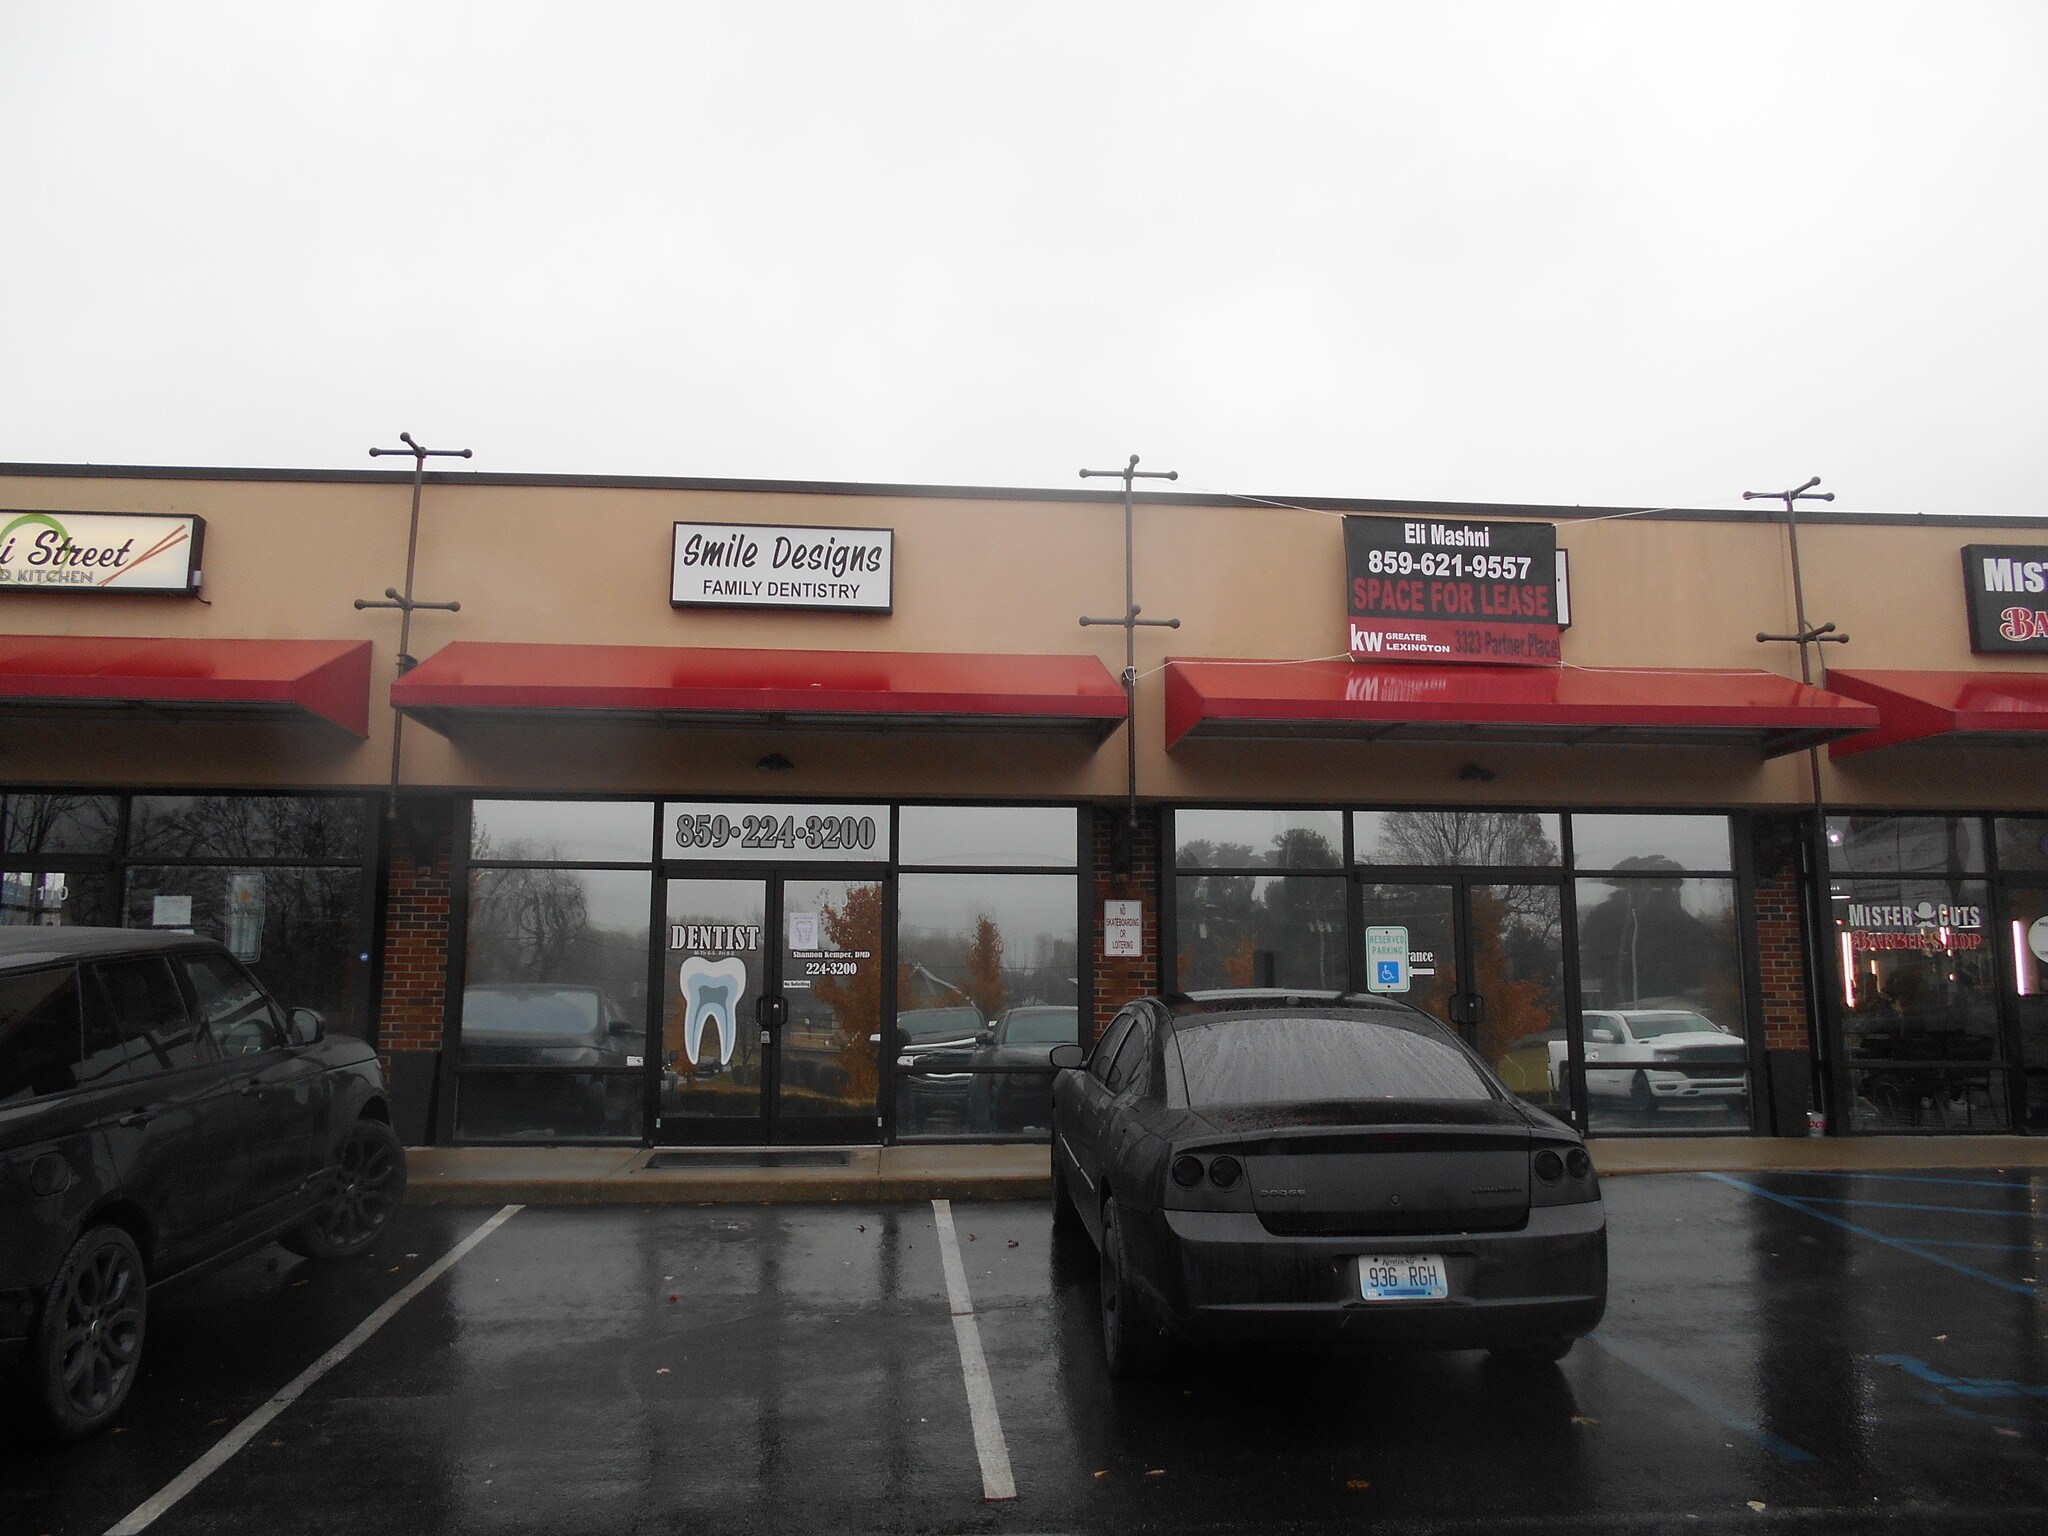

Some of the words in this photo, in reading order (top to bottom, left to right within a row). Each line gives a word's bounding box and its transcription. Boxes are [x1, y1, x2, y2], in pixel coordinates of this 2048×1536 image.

[1404, 523, 1426, 544] Eli
[1431, 524, 1490, 547] Mashni
[0, 537, 16, 565] i
[27, 530, 135, 568] Street
[683, 533, 759, 568] Smile
[772, 536, 883, 578] Designs
[1368, 550, 1531, 580] 859-621-9557
[17, 569, 94, 584] KITCHEN
[703, 580, 762, 596] FAMILY
[767, 581, 861, 599] DENTISTRY
[1353, 577, 1425, 612] SPACE
[1430, 580, 1475, 614] FOR
[1480, 583, 1550, 617] LEASE
[1350, 624, 1383, 652] kw
[1385, 632, 1427, 641] GREATER
[1528, 633, 1558, 657] Place
[1386, 643, 1450, 653] LEXINGTON
[1119, 907, 1127, 915] NO
[1849, 904, 1913, 927] MISTER
[1937, 903, 1980, 927] CUTS
[671, 925, 759, 950] DENTIST
[1119, 929, 1127, 938] OR
[1369, 935, 1405, 944] RESERVED
[1851, 929, 1925, 951] BARBER
[1931, 931, 1982, 952] SHOP
[792, 950, 823, 958] Shannon
[824, 950, 853, 960] Kemper,
[1372, 946, 1403, 955] PARKING
[805, 962, 857, 975] 224-3200
[1369, 1266, 1397, 1287] 936
[1408, 1265, 1438, 1286] RGH
